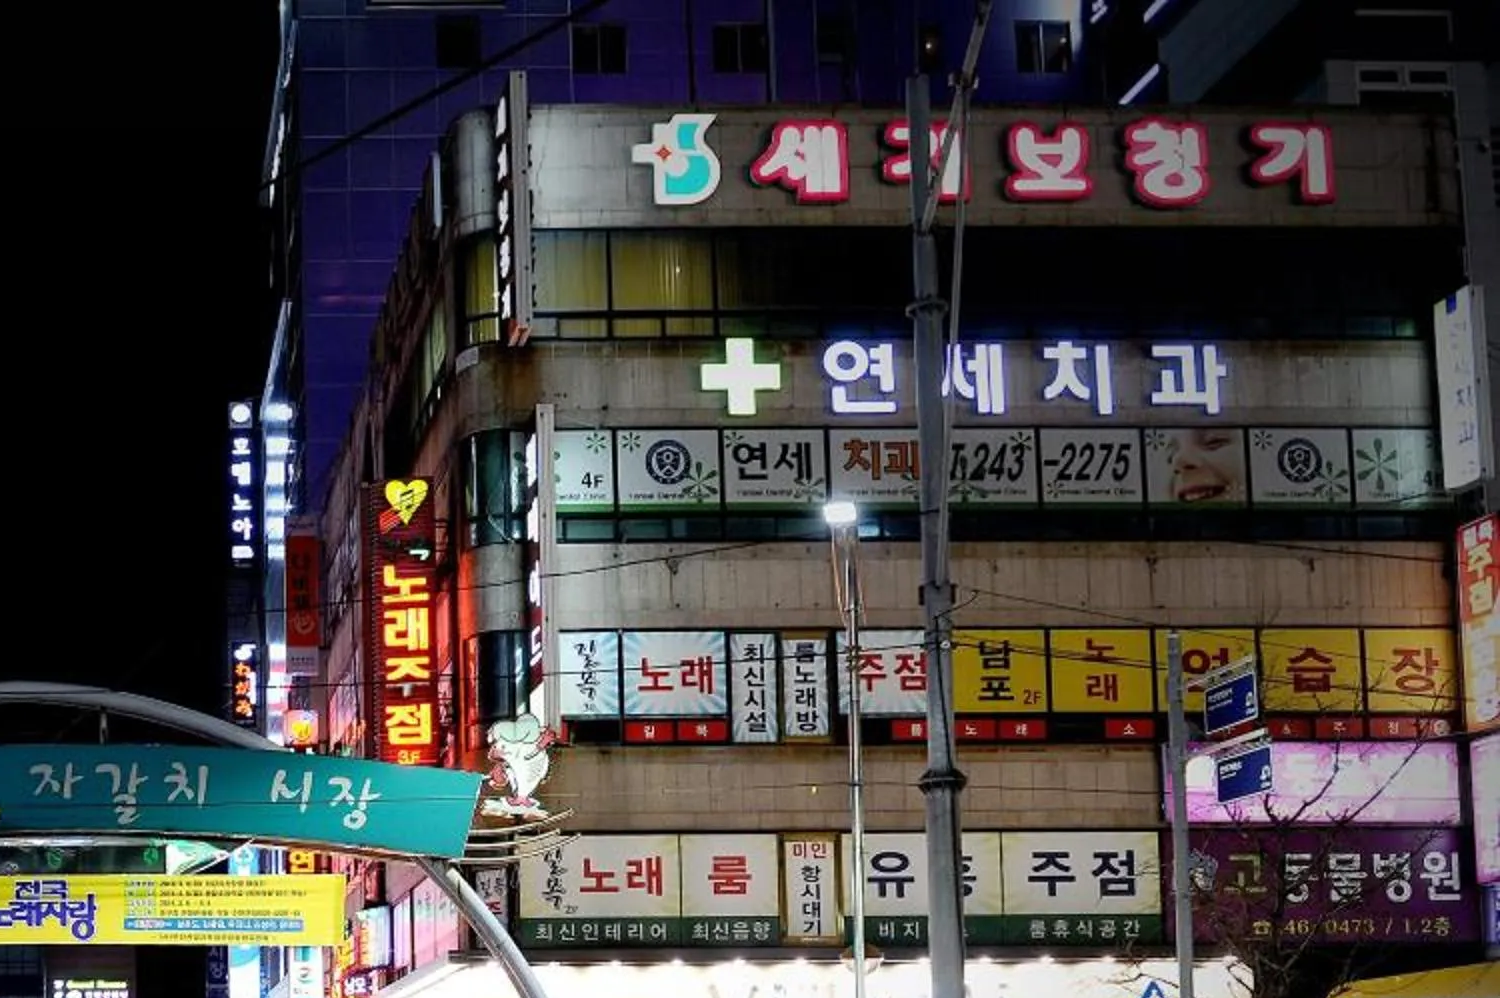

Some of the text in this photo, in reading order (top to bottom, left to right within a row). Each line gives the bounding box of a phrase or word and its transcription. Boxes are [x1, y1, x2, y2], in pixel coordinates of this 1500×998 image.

[752, 118, 1336, 206] 세기보청기
[822, 340, 1228, 416] 연세치과
[581, 472, 604, 489] 4F
[732, 441, 814, 481] 연세
[843, 439, 920, 481] 치과
[382, 564, 430, 746] 노래주점
[638, 655, 713, 696] 노래
[852, 653, 928, 693] 주점
[978, 640, 1015, 701] 남포
[1085, 638, 1119, 702] 노래
[1182, 645, 1440, 694] 연습장
[743, 642, 768, 733] 최신시설
[792, 641, 818, 733] 룸노래방
[1023, 689, 1042, 705] 2F
[30, 762, 208, 826] 자갈치
[269, 769, 380, 830] 시장
[792, 842, 827, 860] 미인
[1027, 850, 1137, 897] 주점
[15, 880, 67, 900] 전국
[579, 855, 752, 897] 노래 룸
[1284, 850, 1461, 904] 동물병원
[801, 865, 822, 939] 항시대기
[535, 923, 668, 941] 최신인테리어
[693, 922, 772, 941] 최신음향
[1029, 919, 1141, 939] 룸휴식공간
